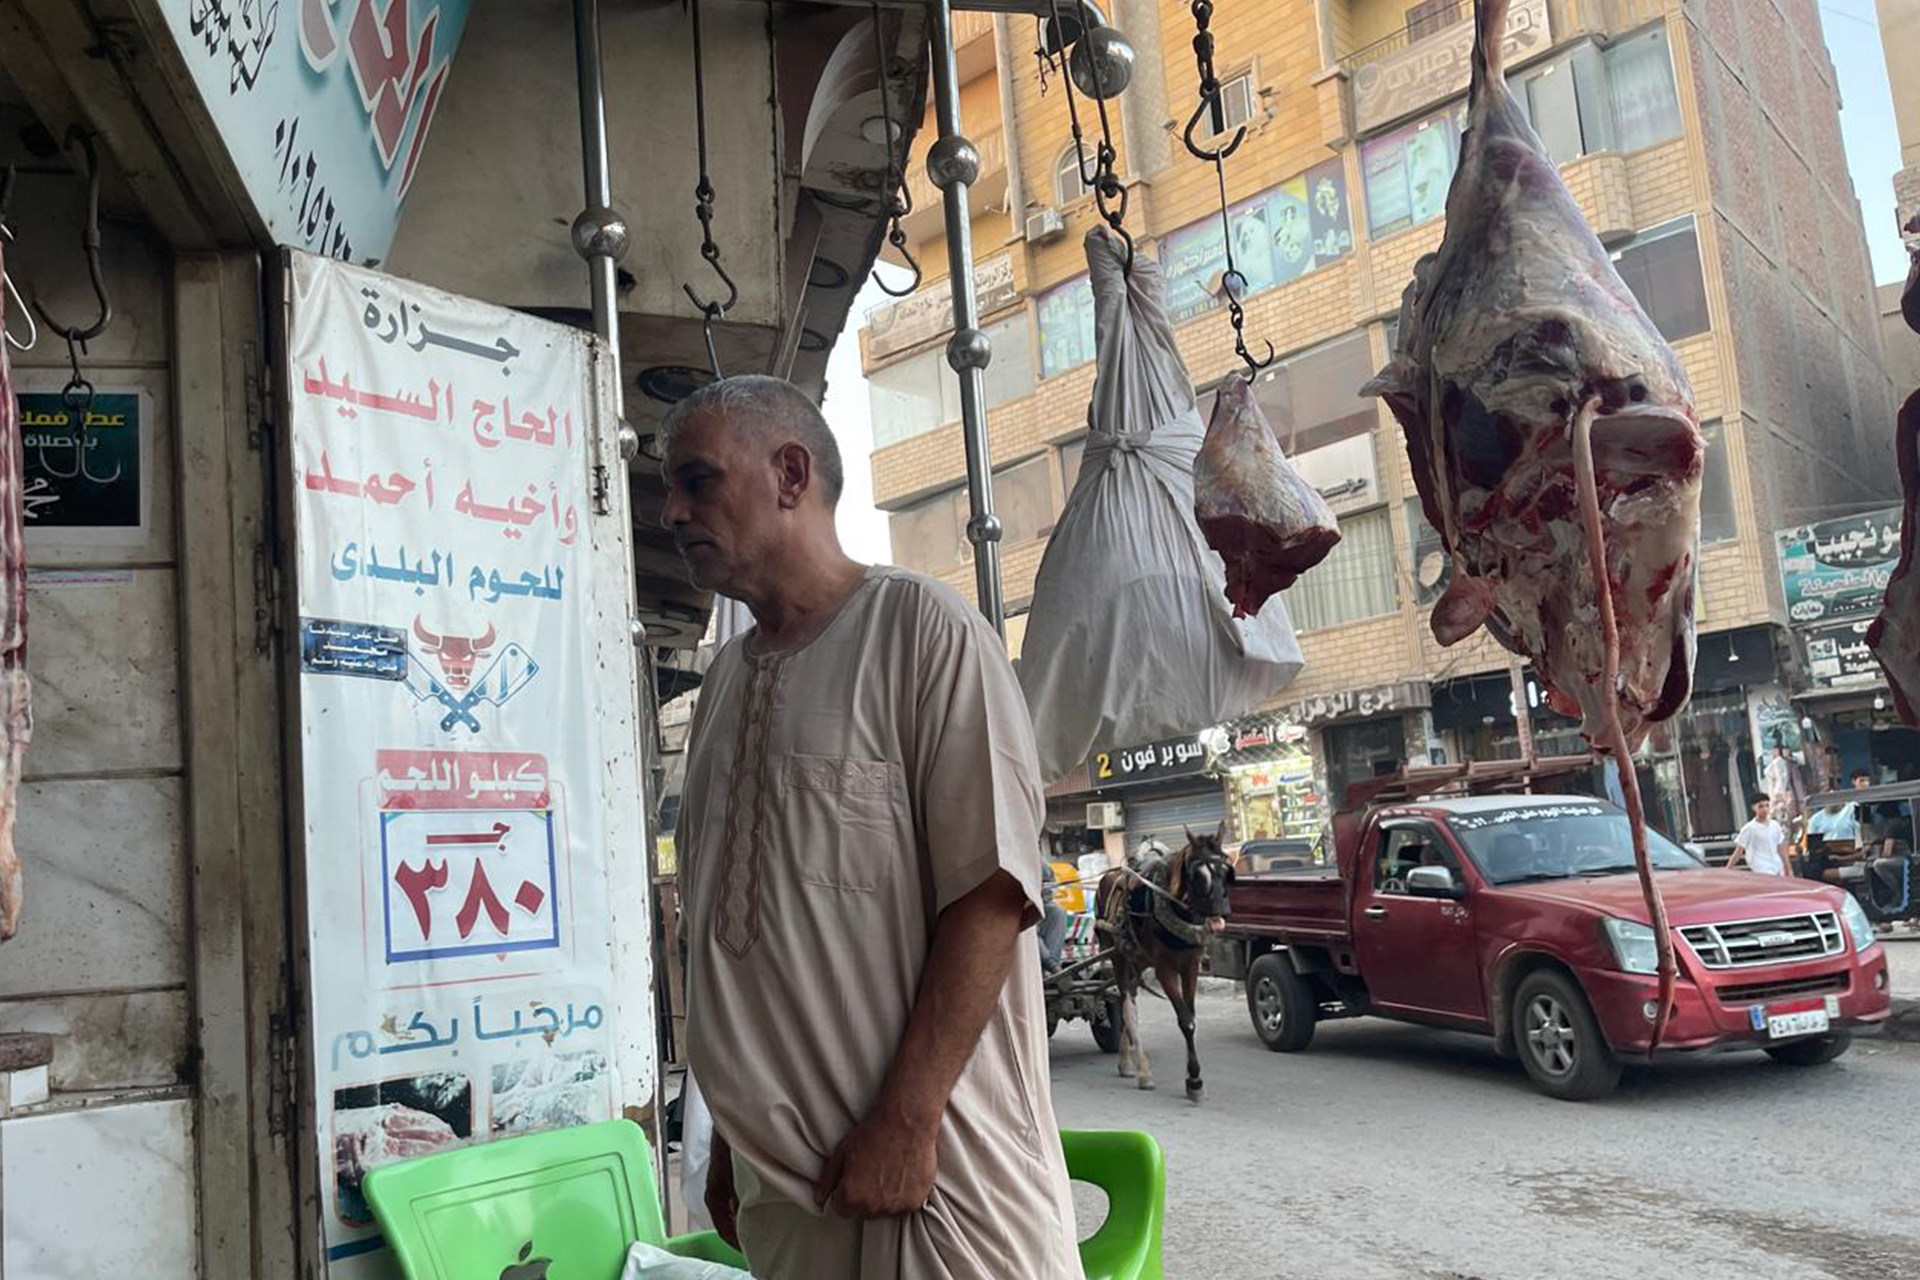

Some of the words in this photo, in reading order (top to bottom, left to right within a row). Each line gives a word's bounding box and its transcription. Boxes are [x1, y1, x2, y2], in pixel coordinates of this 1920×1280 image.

[361, 287, 520, 377] جزارة
[303, 355, 455, 426] السيد
[472, 394, 572, 449] الحاج
[305, 449, 434, 512] أحمد
[455, 478, 580, 546] وأخيه
[1815, 519, 1877, 563] نجيب
[469, 562, 565, 604] للحوم
[323, 641, 388, 656] محمد
[1359, 685, 1394, 717] برج
[1096, 752, 1112, 778] 2
[1121, 743, 1155, 773] فون
[1161, 740, 1204, 767] سوبر
[377, 759, 461, 801] اللحم
[467, 759, 547, 801] كيلو
[394, 857, 545, 943] ٣٨٠
[331, 1010, 459, 1072] بكم
